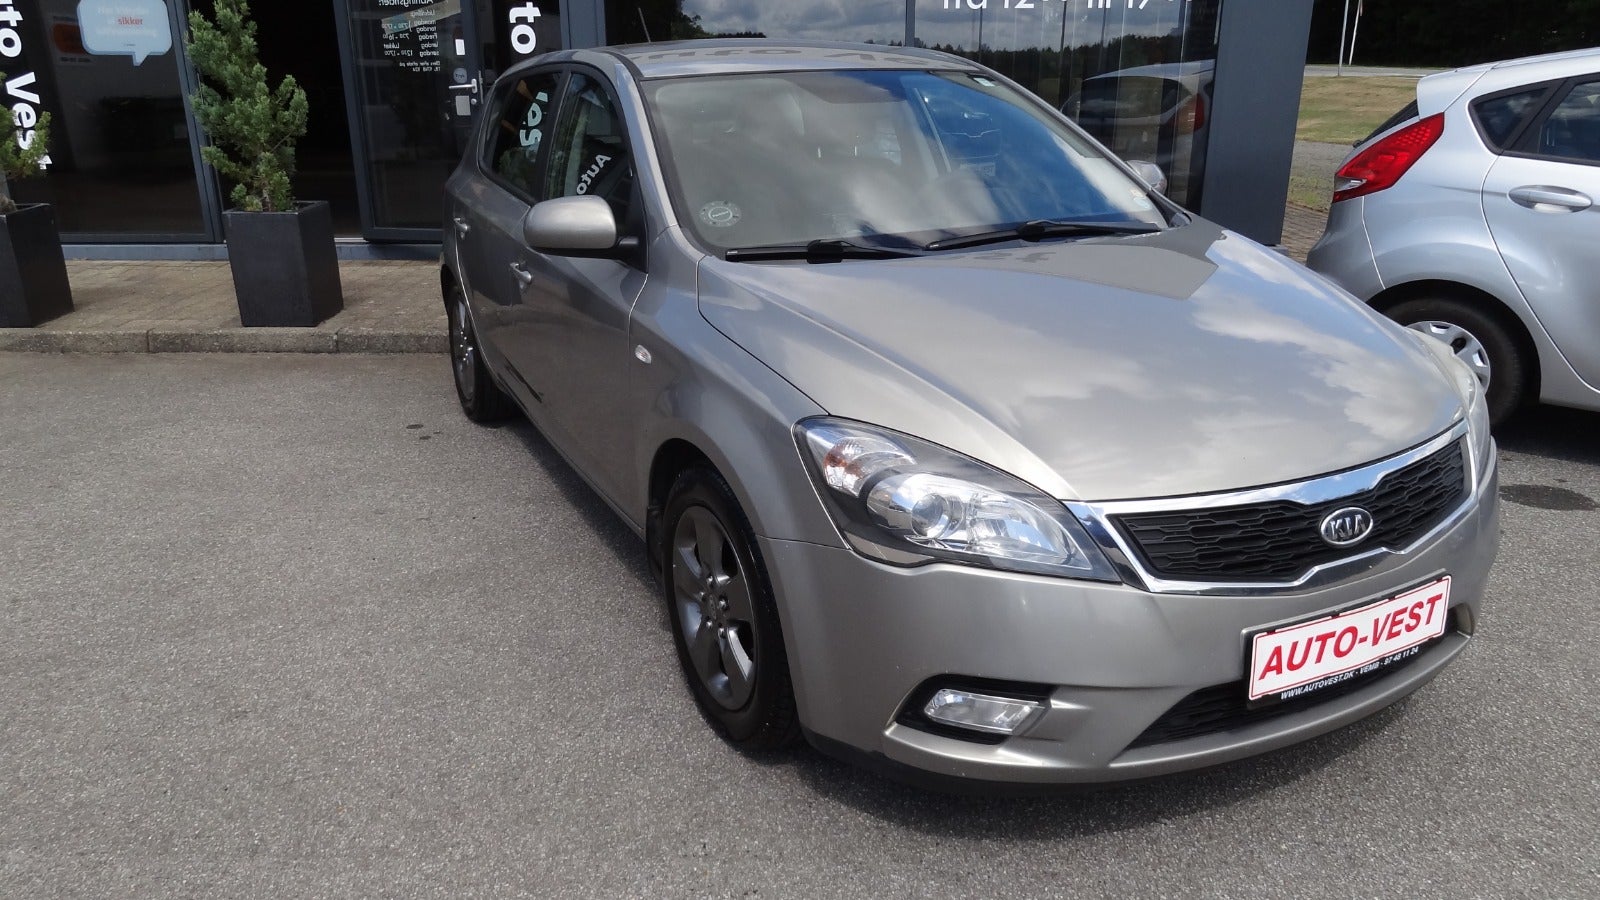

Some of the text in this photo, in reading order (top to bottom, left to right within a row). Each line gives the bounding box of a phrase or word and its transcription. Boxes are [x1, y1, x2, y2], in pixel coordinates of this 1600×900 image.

[118, 16, 143, 26] sikker
[1329, 514, 1367, 540] KIA
[1258, 593, 1443, 680] AUTO-VEST
[1281, 669, 1354, 700] WWW.AUTOVEST.DK
[1359, 661, 1380, 675] VEMB
